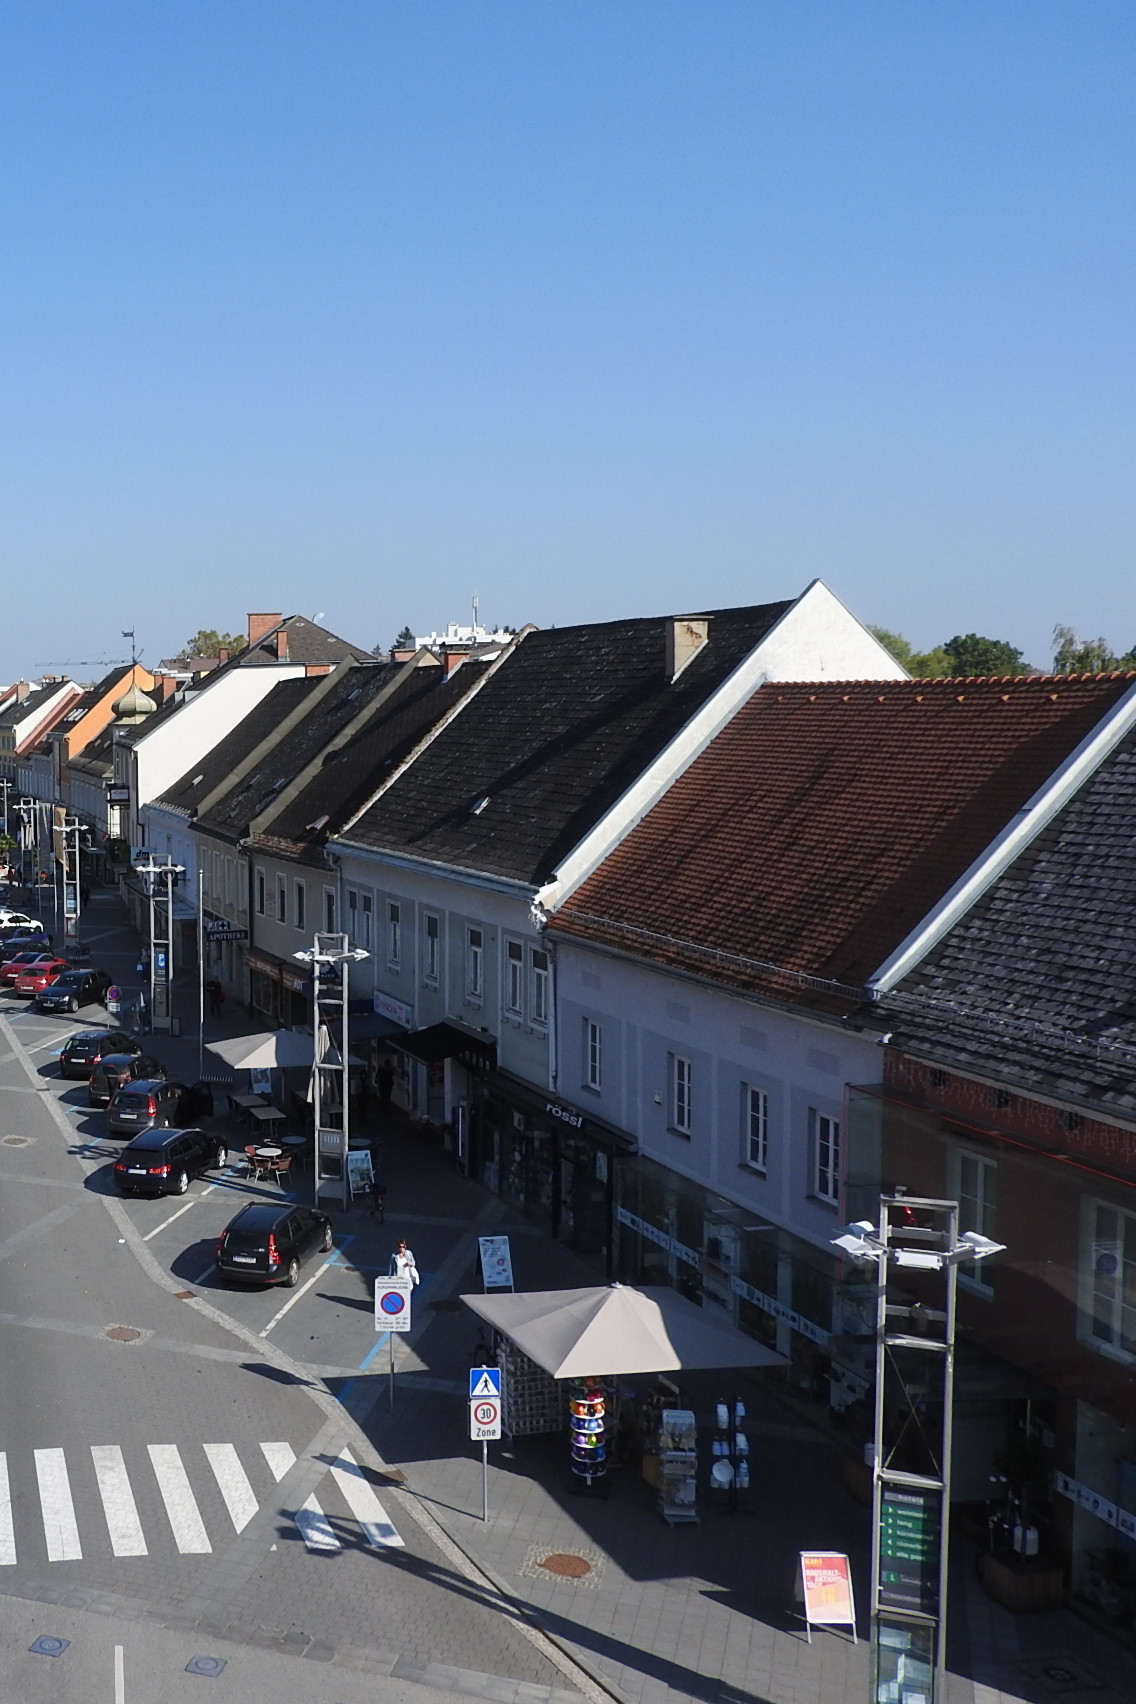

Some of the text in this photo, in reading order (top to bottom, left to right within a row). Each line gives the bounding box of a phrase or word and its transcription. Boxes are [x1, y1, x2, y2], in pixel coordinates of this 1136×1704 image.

[208, 931, 246, 941] APOTHEKE
[545, 1103, 583, 1128] rössl
[480, 1408, 492, 1420] 30
[476, 1427, 497, 1438] Zone
